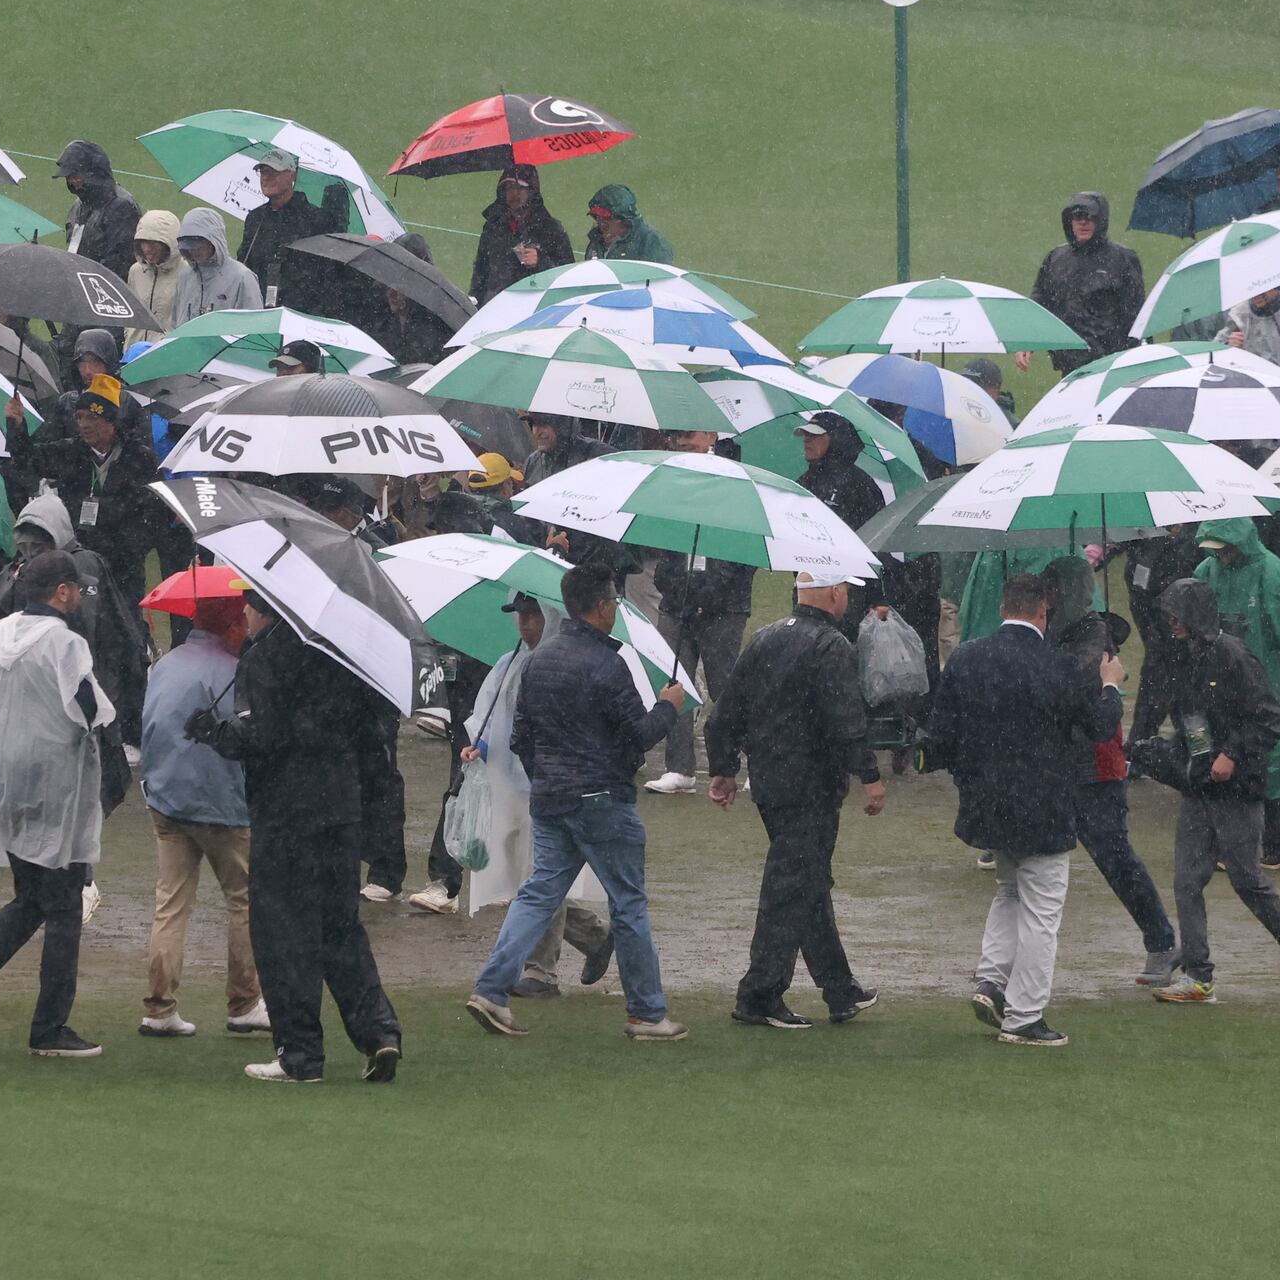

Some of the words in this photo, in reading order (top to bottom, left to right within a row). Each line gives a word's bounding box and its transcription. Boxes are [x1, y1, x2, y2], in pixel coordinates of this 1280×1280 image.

[96, 302, 129, 315] PING
[182, 425, 252, 464] NG
[320, 425, 445, 465] PING
